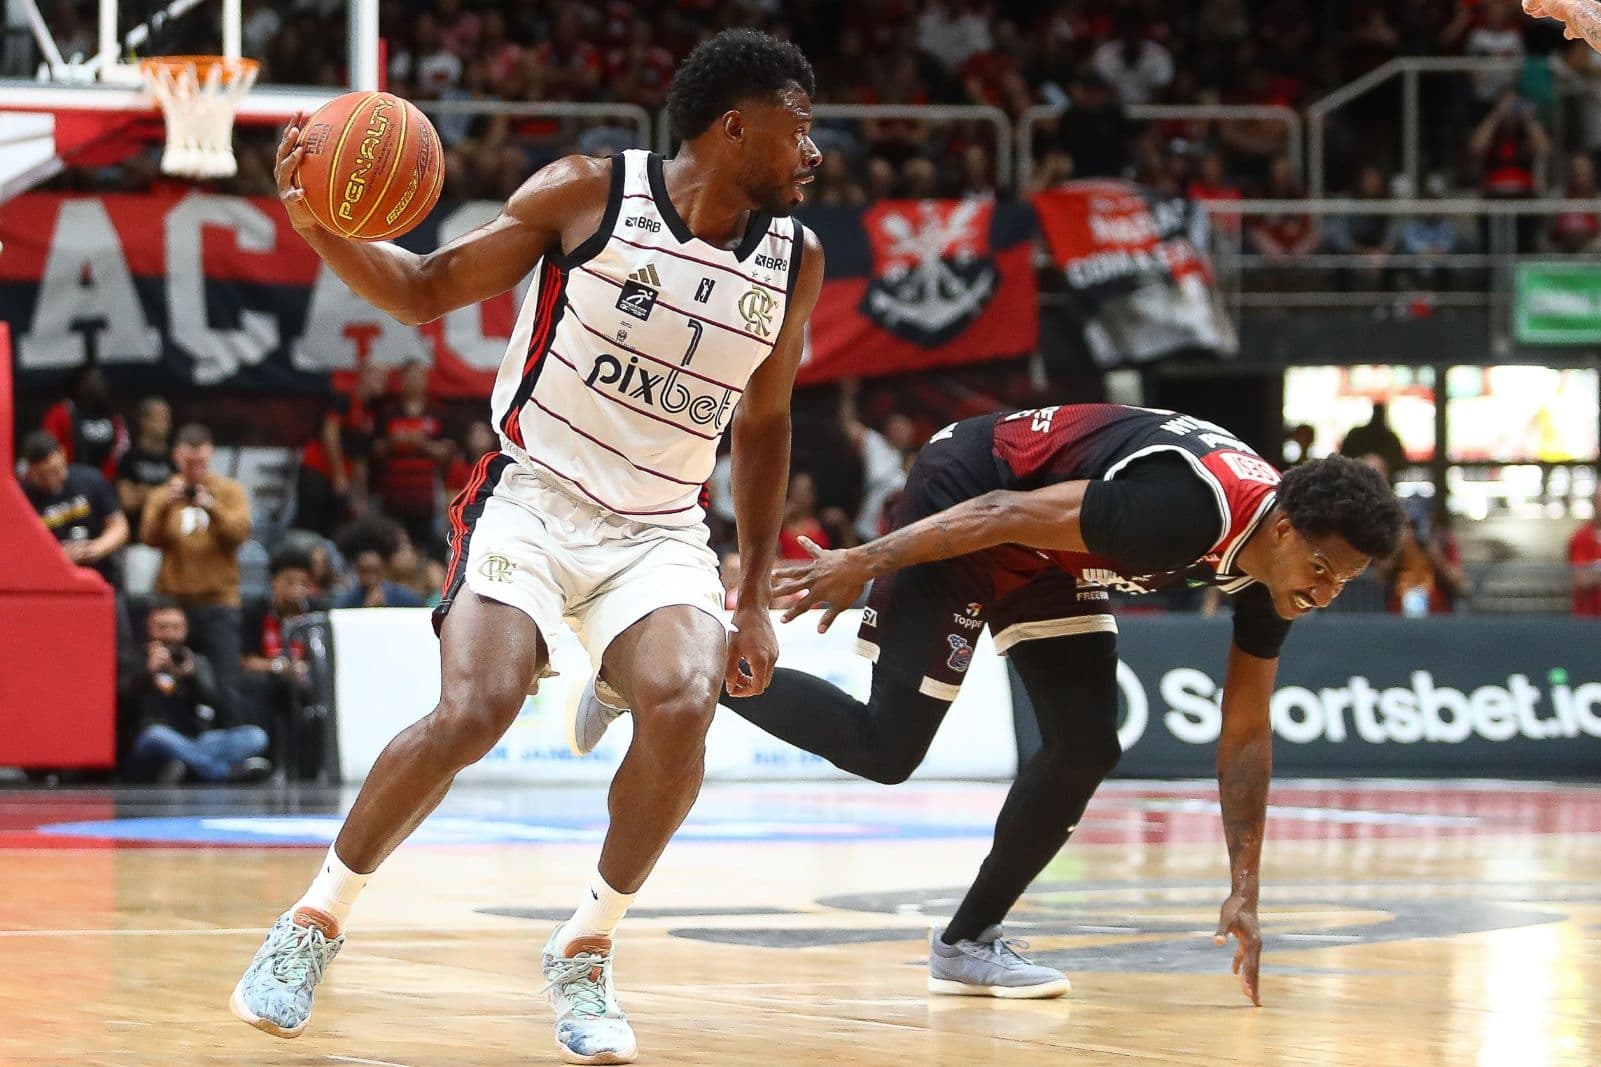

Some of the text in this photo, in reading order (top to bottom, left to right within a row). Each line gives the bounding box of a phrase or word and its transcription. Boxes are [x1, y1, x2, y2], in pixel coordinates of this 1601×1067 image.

[338, 97, 395, 221] PENALTY
[637, 216, 662, 233] BRB
[766, 257, 788, 272] BRB
[586, 353, 733, 430] pixbet
